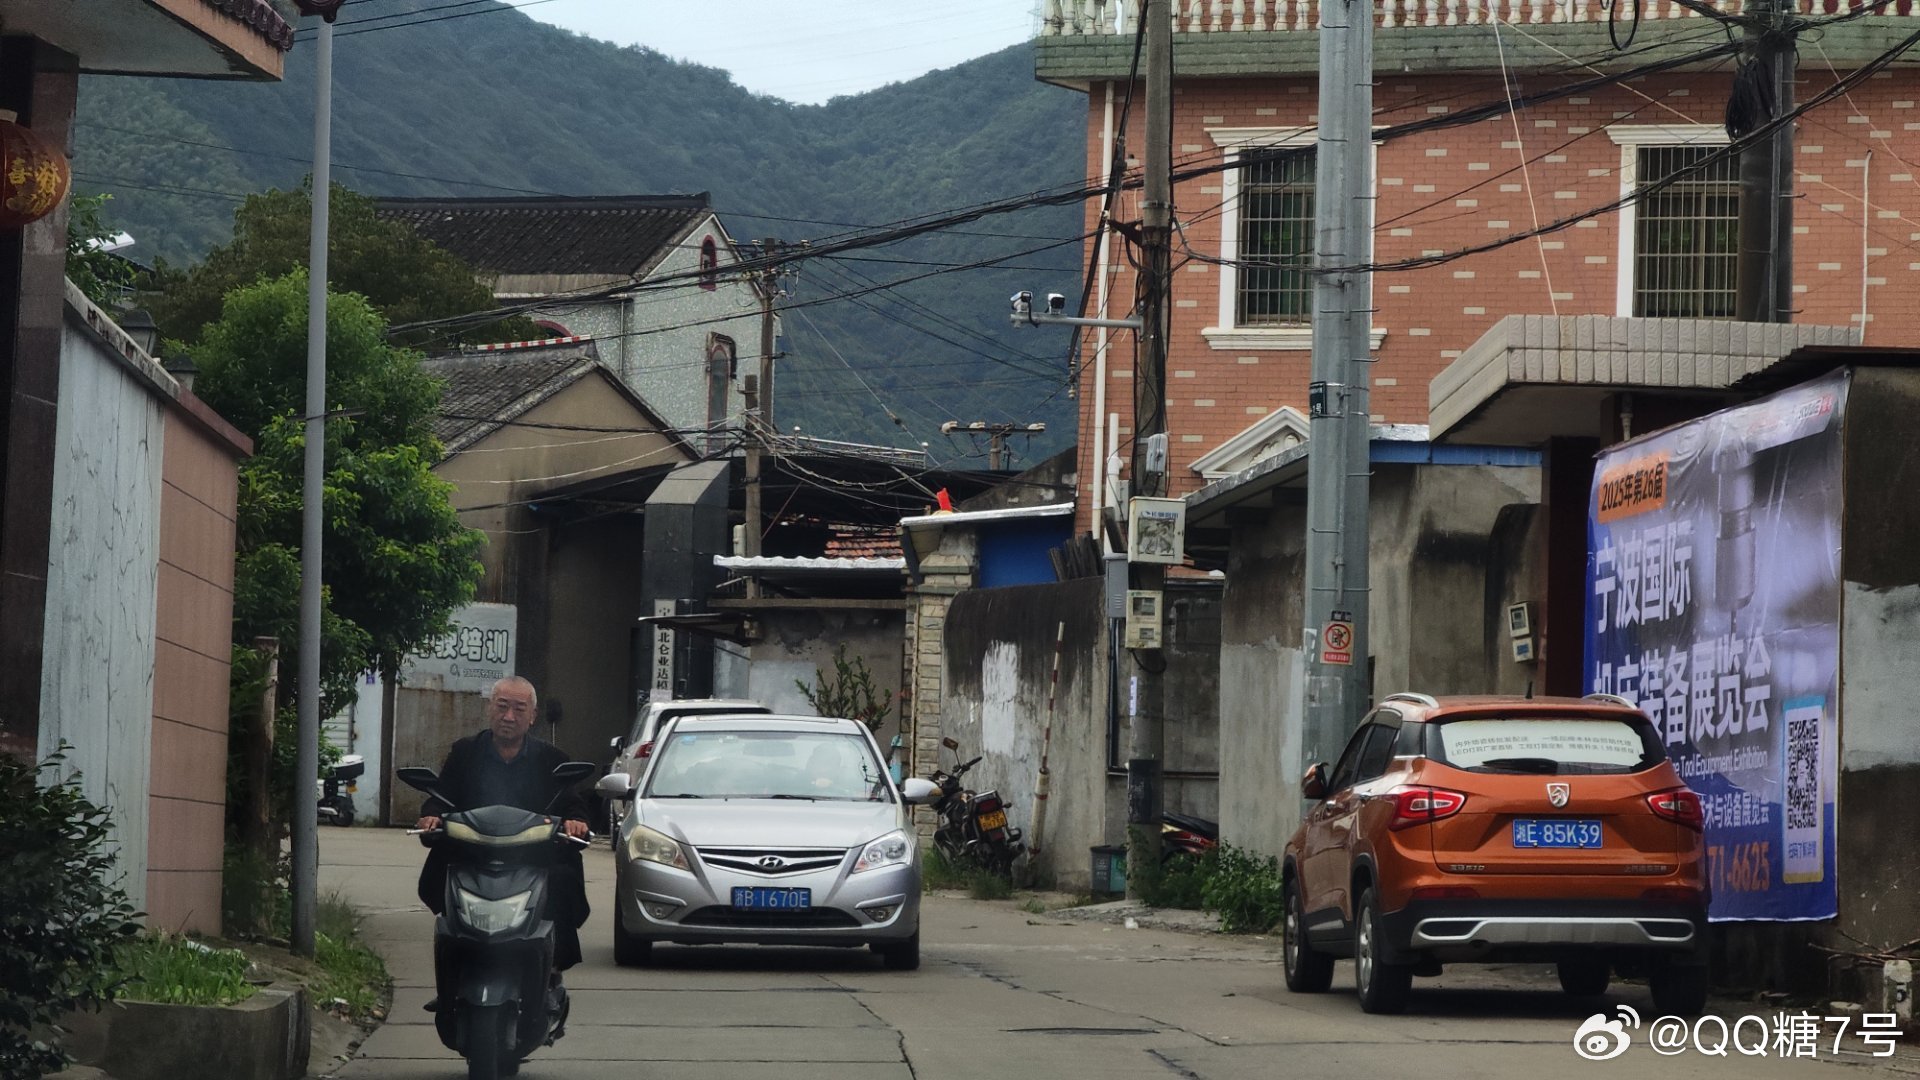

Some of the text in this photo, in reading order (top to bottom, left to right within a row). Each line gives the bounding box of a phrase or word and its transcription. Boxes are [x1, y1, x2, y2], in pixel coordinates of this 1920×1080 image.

[1600, 460, 1664, 511] 2025年第26届
[1595, 522, 1693, 634] 宁波国际
[1680, 754, 1695, 778] Tool
[1696, 750, 1733, 781] Equipment
[1734, 746, 1768, 771] Exhibition
